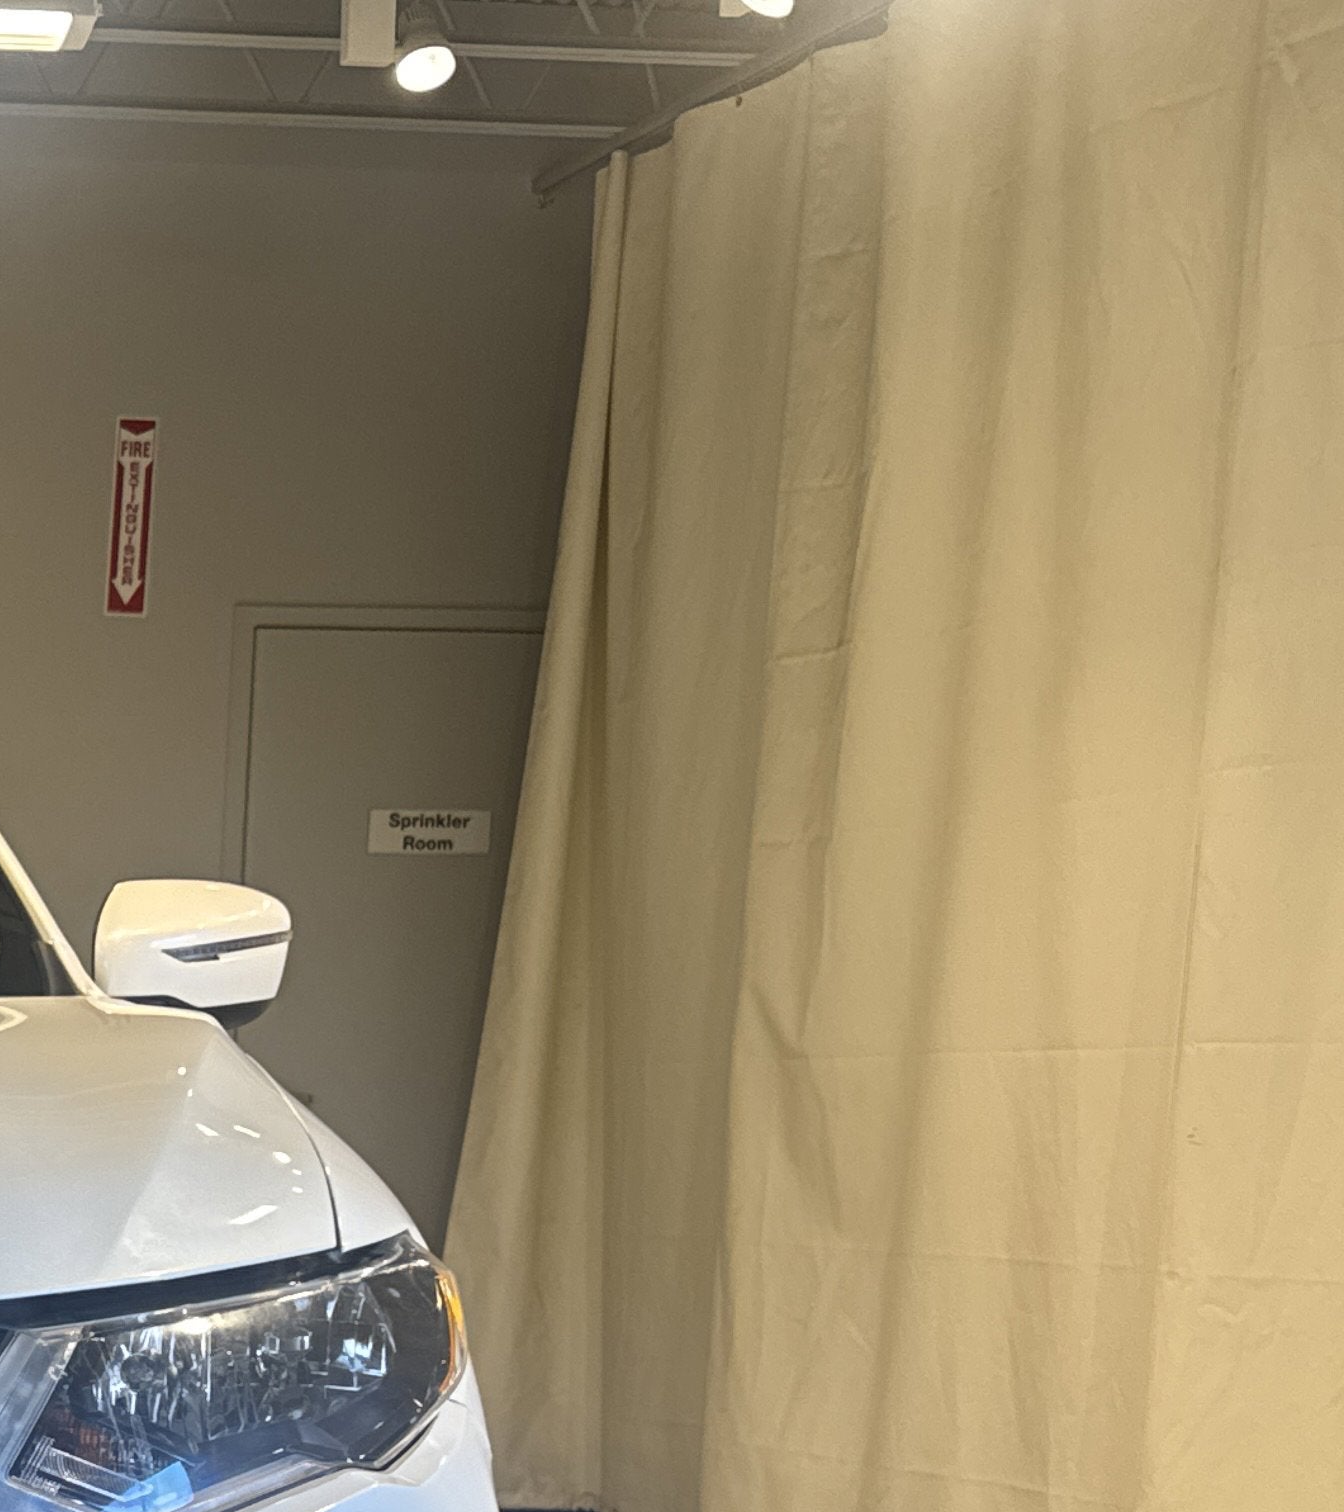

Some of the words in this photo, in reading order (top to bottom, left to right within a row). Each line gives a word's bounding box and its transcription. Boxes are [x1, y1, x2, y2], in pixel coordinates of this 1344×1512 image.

[120, 441, 151, 458] FIRE
[121, 462, 140, 586] EXTINGUISHER
[388, 812, 471, 830] Sprinkler
[402, 836, 453, 851] Room
